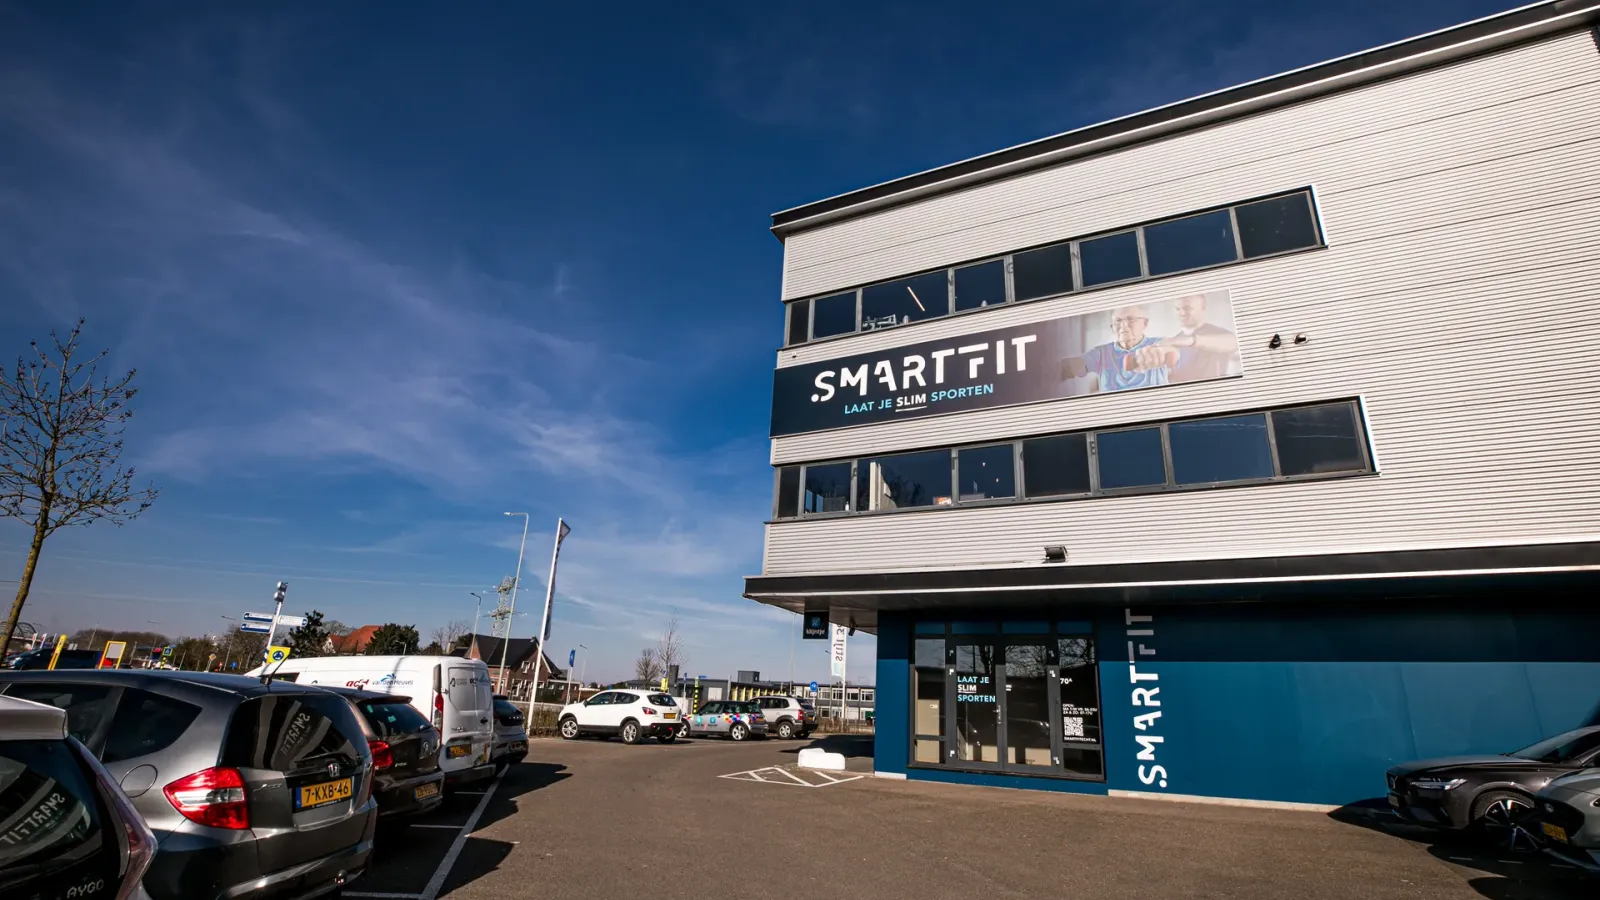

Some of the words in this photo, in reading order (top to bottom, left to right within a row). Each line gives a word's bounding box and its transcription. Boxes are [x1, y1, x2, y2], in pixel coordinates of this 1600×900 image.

[844, 401, 875, 415] LAAT
[878, 398, 893, 410] JE
[896, 393, 927, 407] SLIM
[931, 383, 994, 402] SPORTEN
[979, 676, 990, 684] JE
[957, 694, 996, 703] SPORTEN
[304, 781, 349, 803] 7-KXB-46
[67, 879, 105, 899] AYGO
